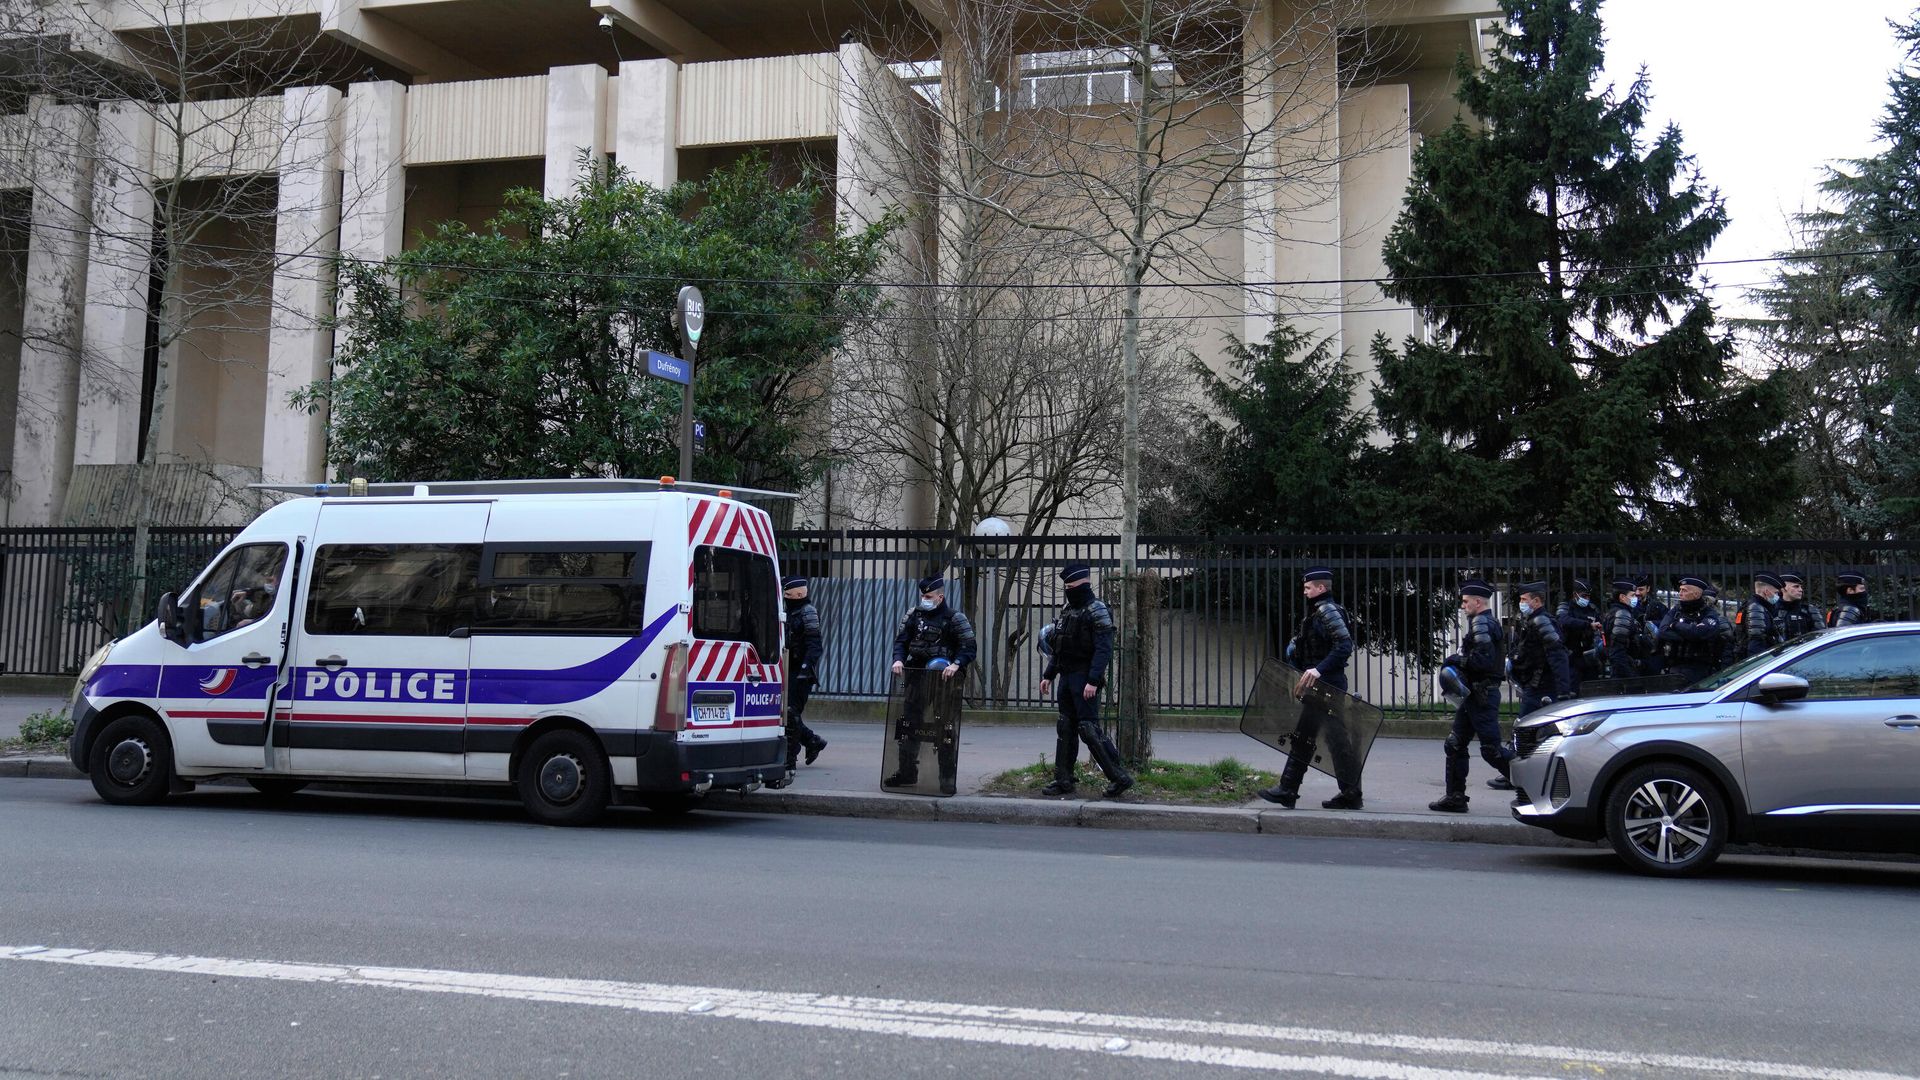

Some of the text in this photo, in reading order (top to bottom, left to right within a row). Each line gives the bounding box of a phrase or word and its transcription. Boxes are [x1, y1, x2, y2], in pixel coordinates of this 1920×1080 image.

[687, 299, 702, 319] BUS
[657, 359, 681, 378] Dufrénoy
[695, 423, 704, 437] PC
[304, 671, 455, 700] POLICE
[745, 693, 769, 706] POLICE
[914, 728, 937, 737] POLICE
